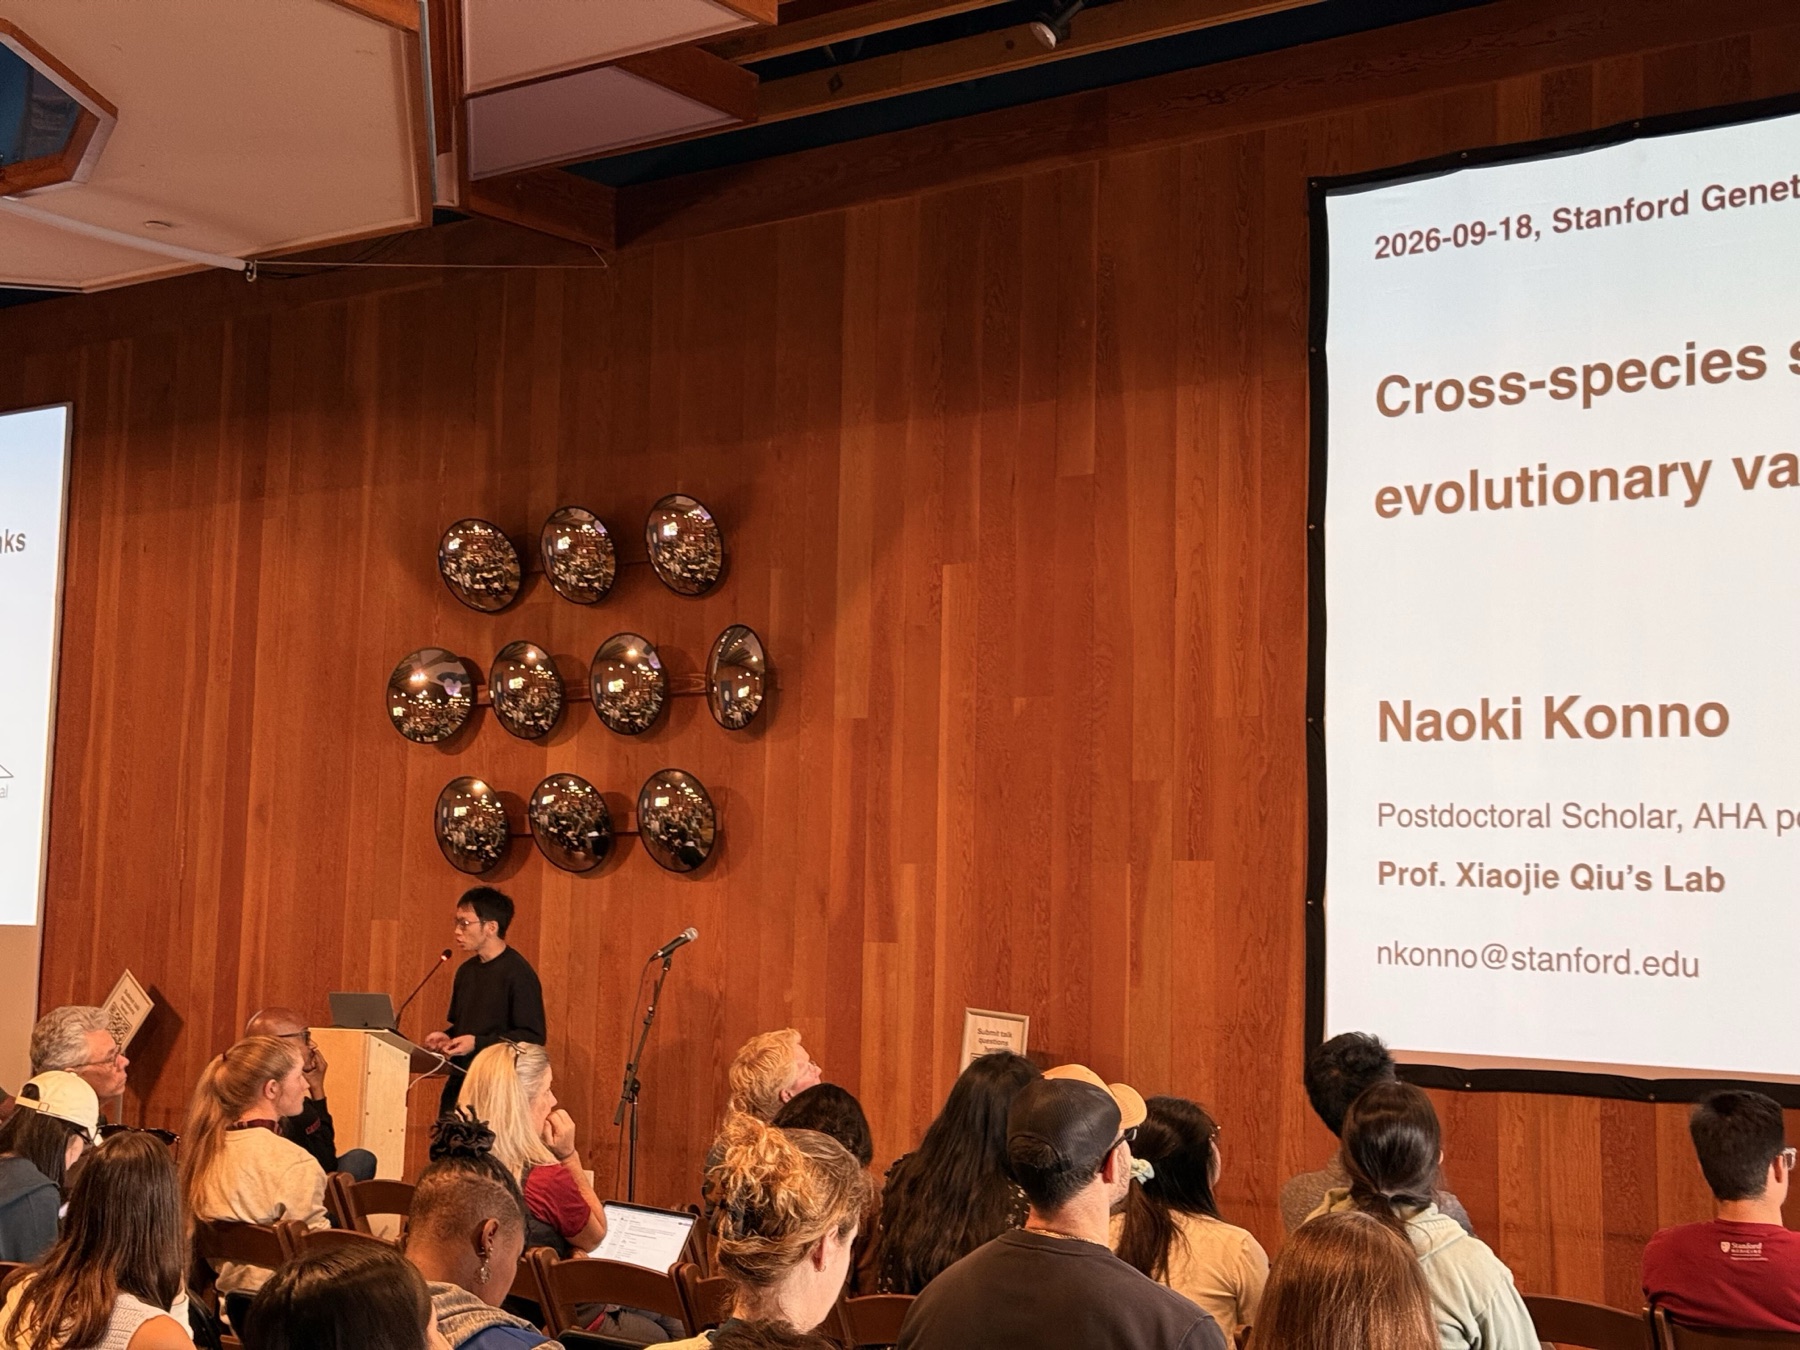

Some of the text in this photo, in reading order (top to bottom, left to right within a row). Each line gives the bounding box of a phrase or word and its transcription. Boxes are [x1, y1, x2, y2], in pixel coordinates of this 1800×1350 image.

[1374, 173, 1800, 260] 2026-09-18, Stanford Genet
[1376, 340, 1768, 418] Cross-species
[1375, 452, 1800, 519] evolutionary va
[0, 528, 26, 554] ks
[1379, 695, 1730, 743] Naoki Konno
[1378, 802, 1800, 837] Postdoctoral Scholar, AHA p
[1378, 861, 1726, 896] Prof. Xiaojie Qiu’s Lab
[1377, 940, 1699, 978] nkonno@stanford.edu
[977, 1028, 999, 1037] Submit
[978, 1038, 1009, 1046] questions
